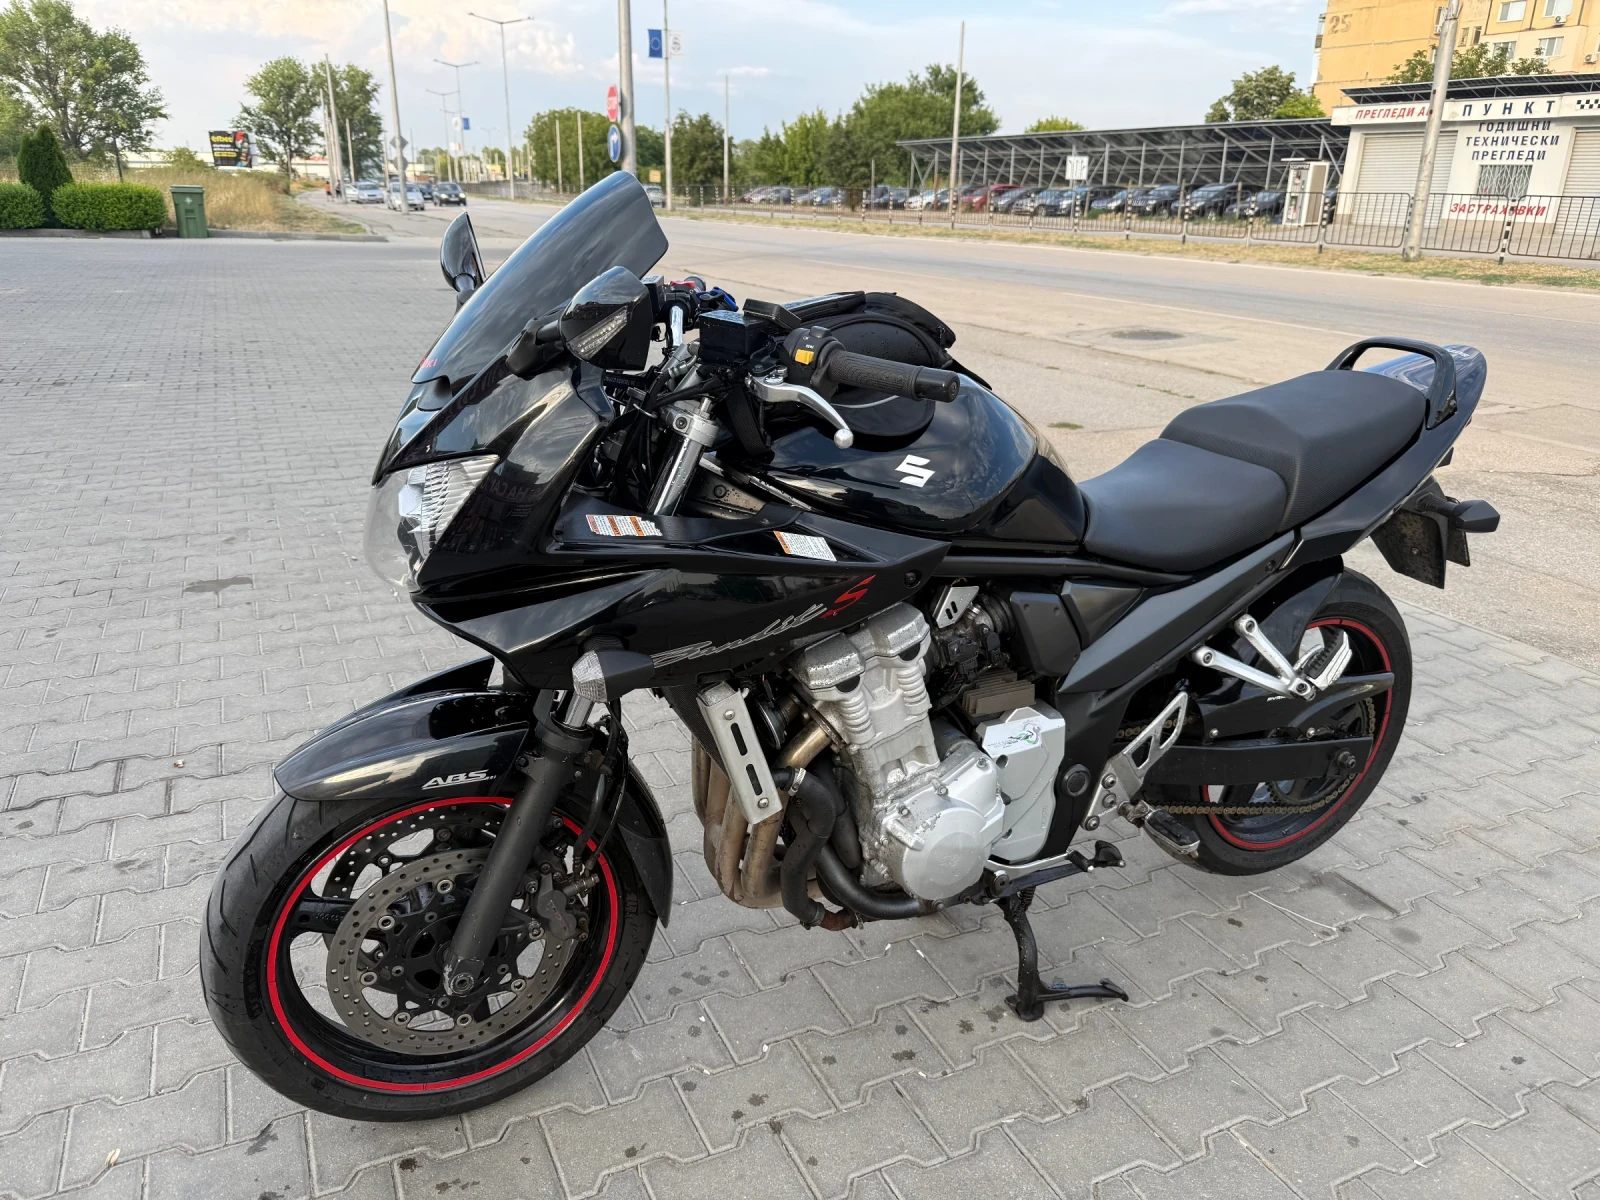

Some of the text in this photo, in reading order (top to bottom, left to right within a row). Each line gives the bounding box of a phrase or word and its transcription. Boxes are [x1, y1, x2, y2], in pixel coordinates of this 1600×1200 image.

[1328, 13, 1353, 35] 25
[1355, 107, 1415, 119] ПРЕГЛЕДИ
[1462, 100, 1555, 116] ПУНКТ
[1478, 120, 1551, 133] ГОДИШНИ
[1465, 135, 1560, 147] ТЕХНИЧЕСКИ
[1471, 150, 1546, 161] ПРЕГЛЕДИ
[421, 769, 489, 790] ABS
